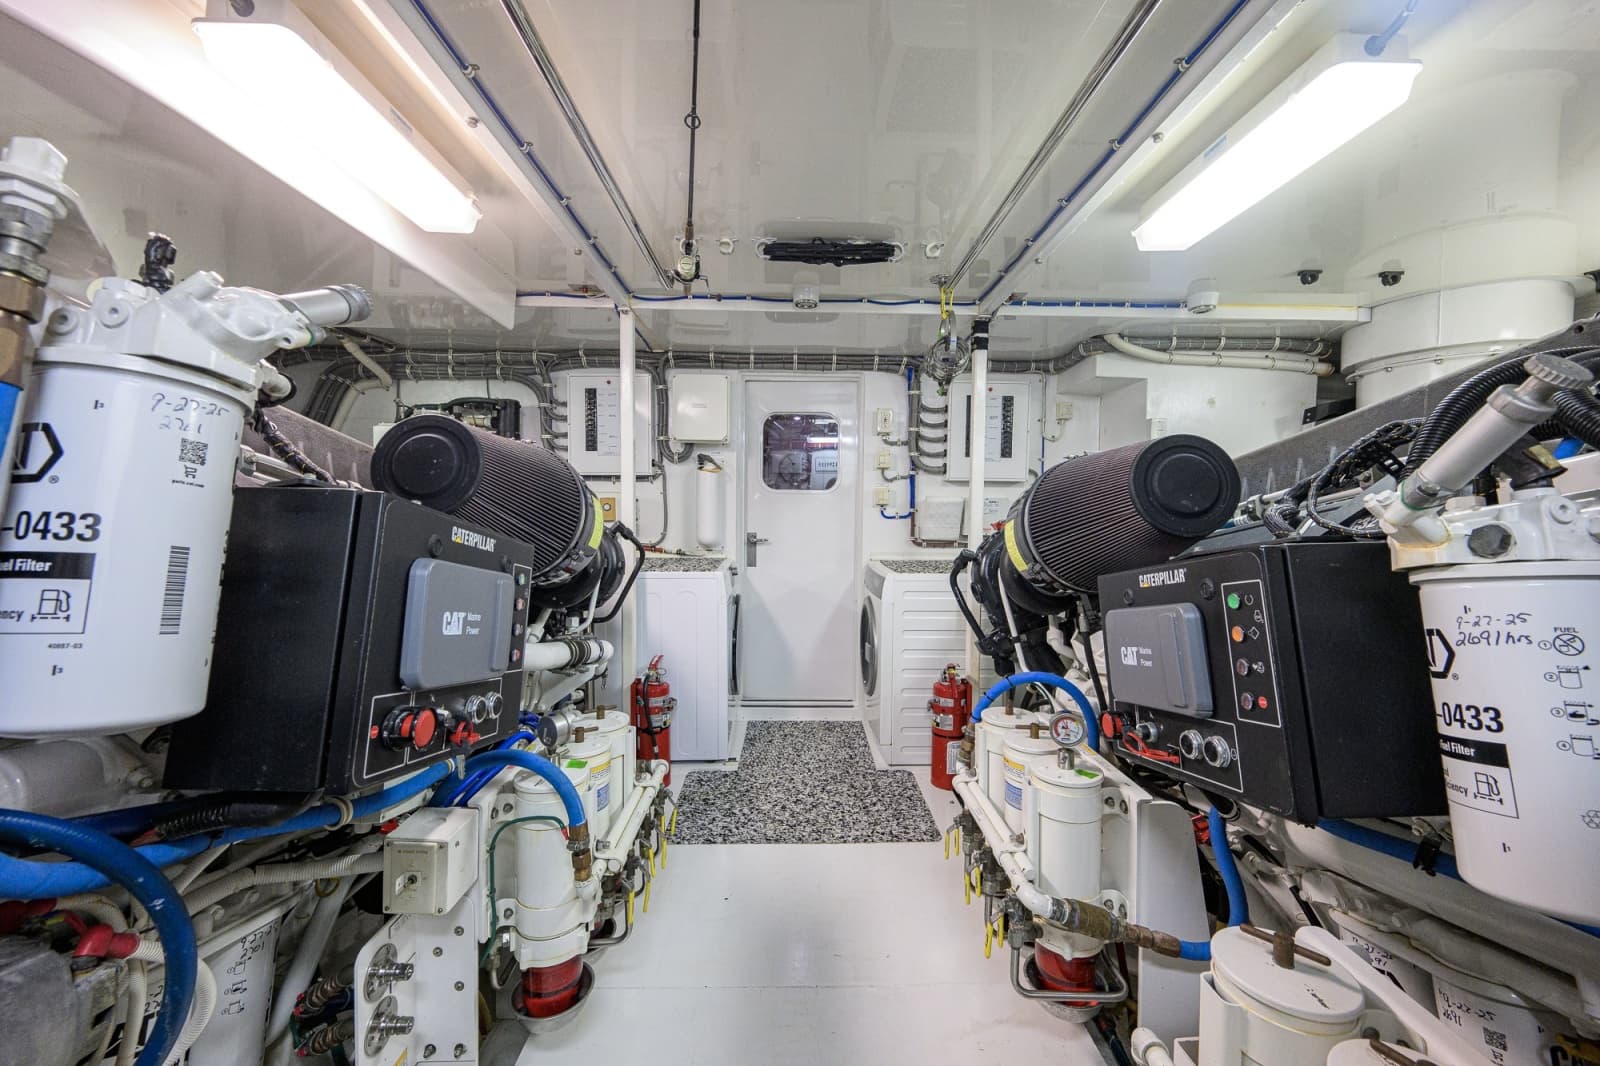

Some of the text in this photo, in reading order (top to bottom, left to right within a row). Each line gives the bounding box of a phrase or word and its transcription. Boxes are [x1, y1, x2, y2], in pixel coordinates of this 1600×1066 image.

[452, 526, 496, 552] CATERPILLAR
[14, 558, 53, 573] Filter
[1138, 568, 1187, 589] CATERPILLAR
[442, 611, 466, 635] CAT
[1456, 613, 1532, 629] 9-27-25
[1455, 630, 1533, 647] 2691 hrs
[1553, 626, 1580, 634] FUEL
[1120, 646, 1138, 666] CAT
[1451, 742, 1476, 757] Filter
